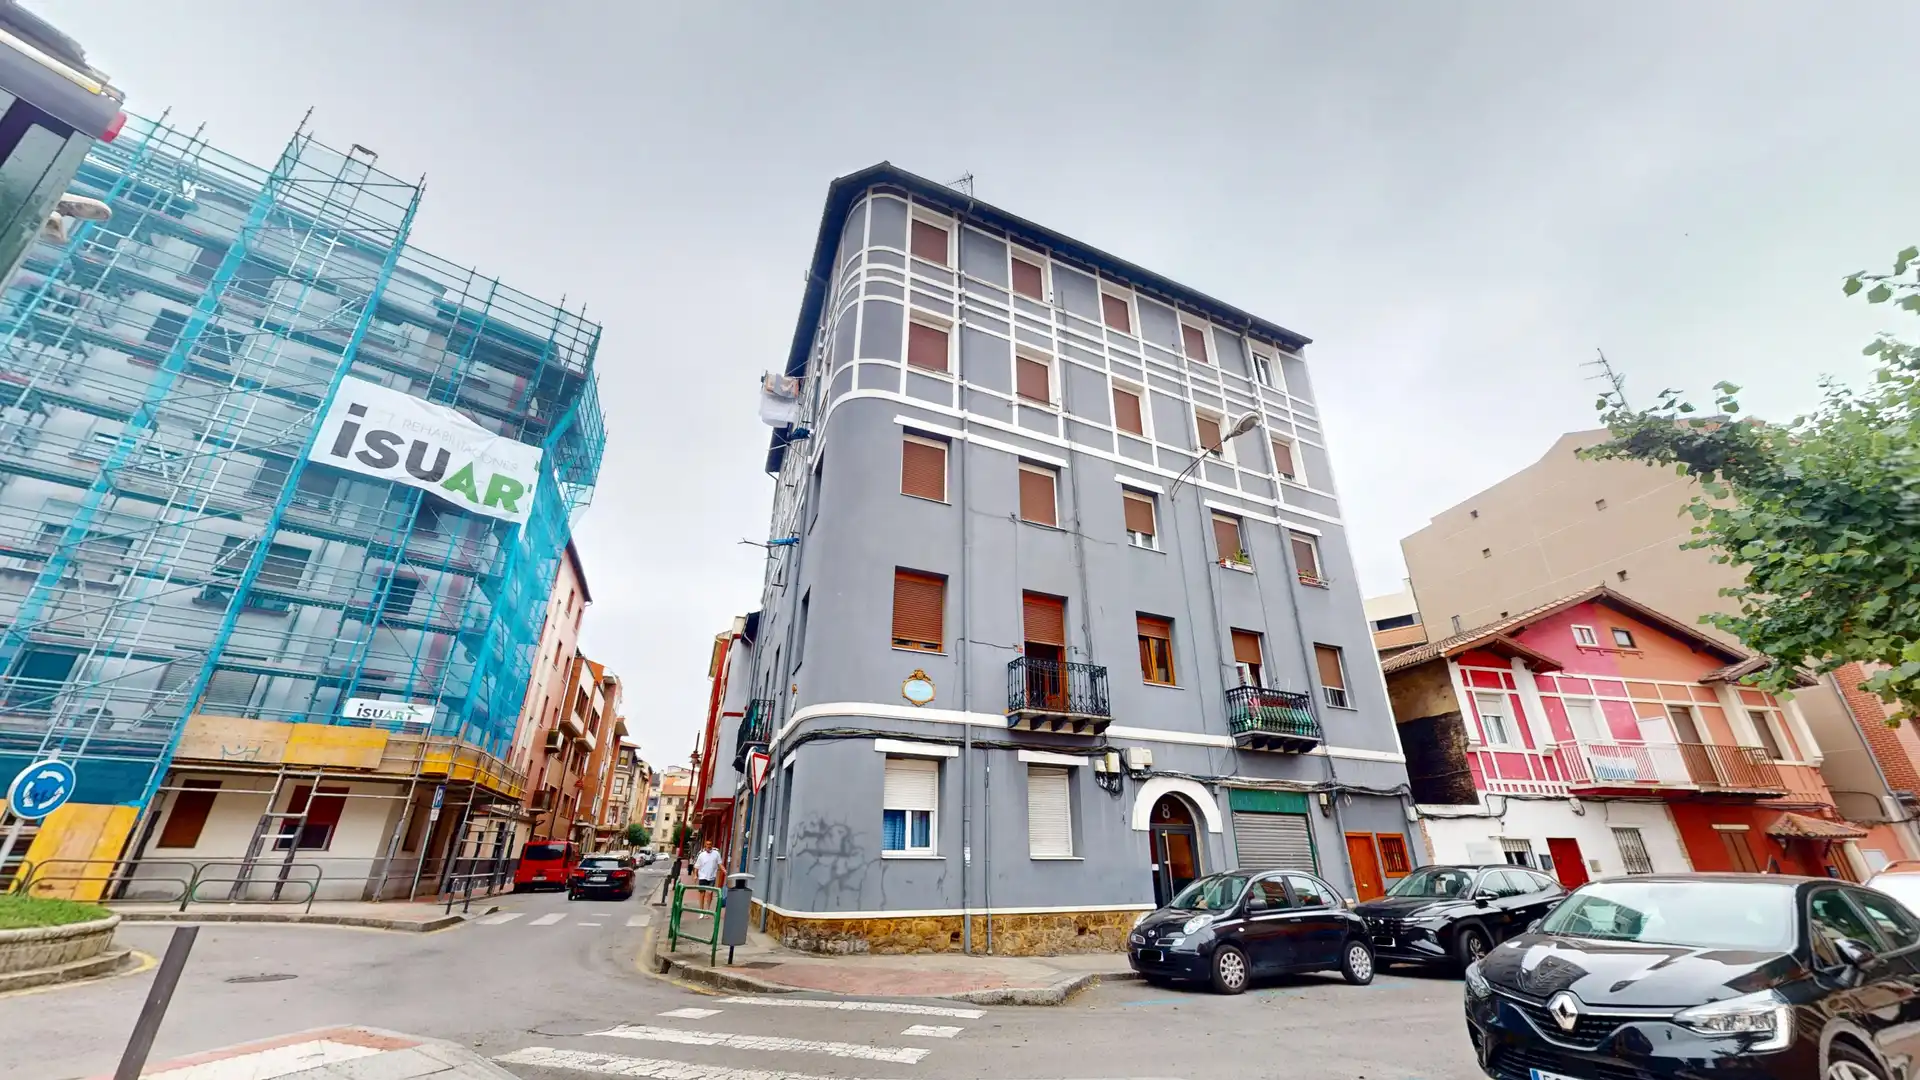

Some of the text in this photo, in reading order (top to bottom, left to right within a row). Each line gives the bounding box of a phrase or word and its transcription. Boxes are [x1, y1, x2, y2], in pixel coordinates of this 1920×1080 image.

[331, 403, 533, 513] isuAR
[435, 788, 444, 805] P
[1161, 803, 1171, 819] 8
